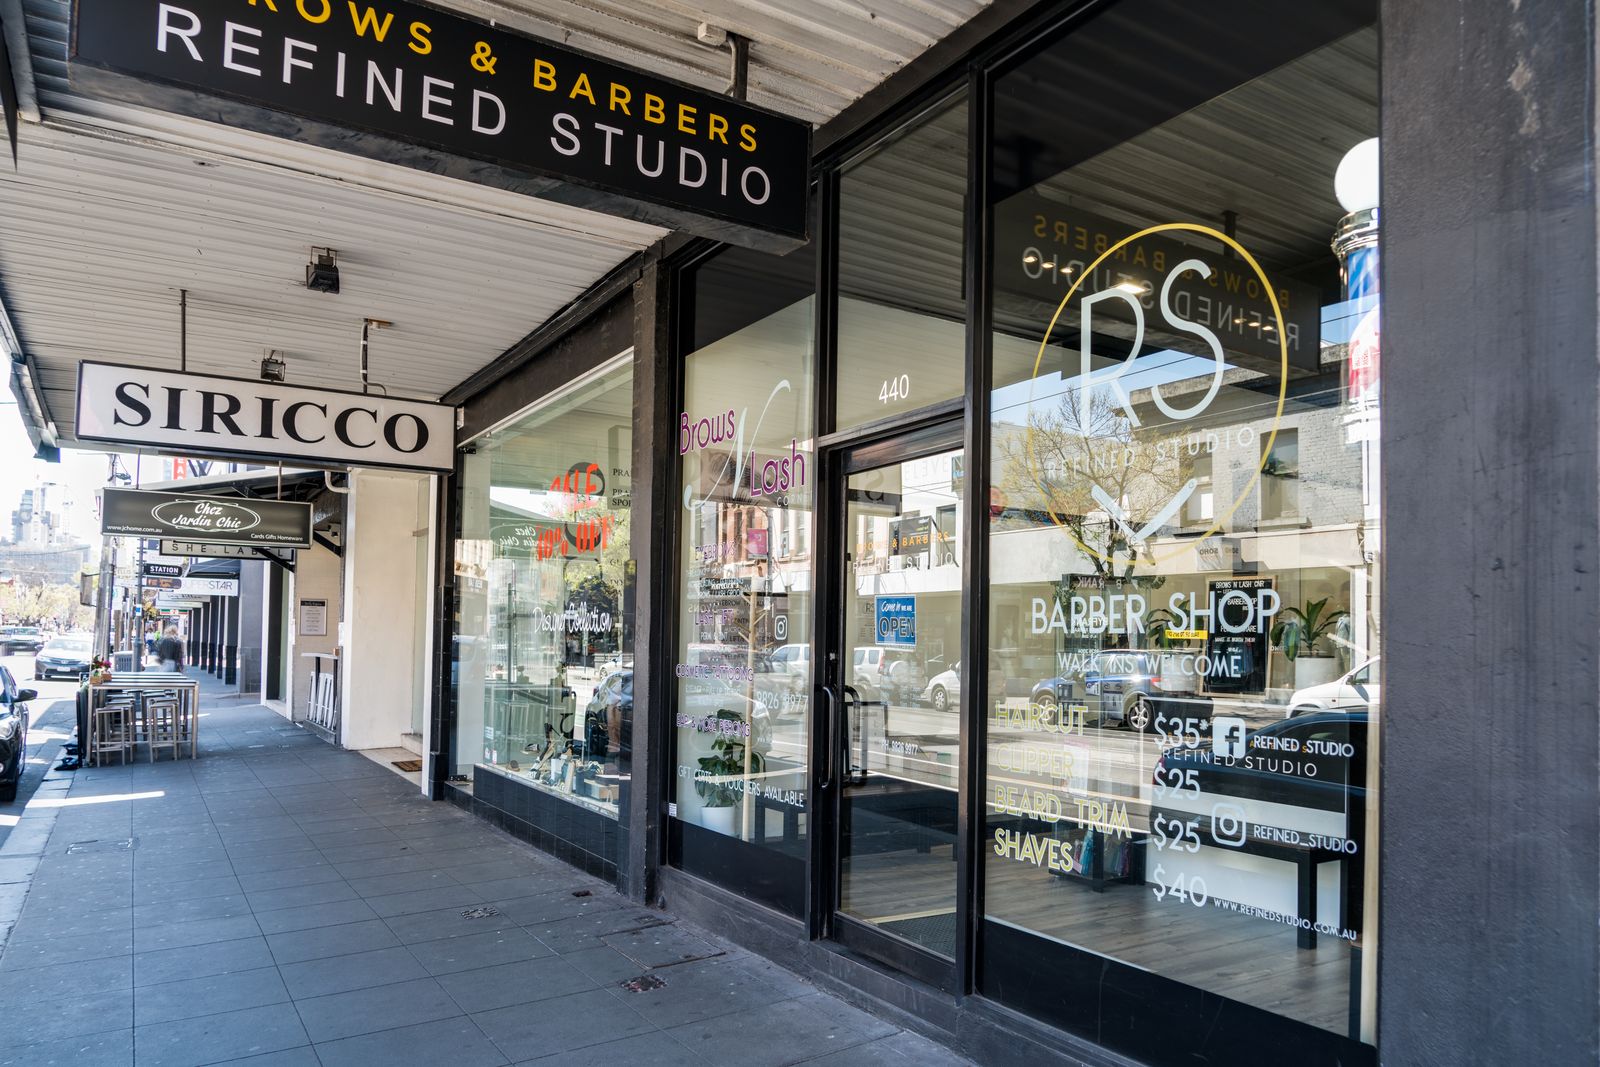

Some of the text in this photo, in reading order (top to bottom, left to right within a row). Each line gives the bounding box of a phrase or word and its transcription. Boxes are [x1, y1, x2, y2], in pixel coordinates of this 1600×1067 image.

[155, 3, 771, 205] REFINED STUDIO
[470, 41, 497, 75] &
[533, 57, 759, 153] BARBERS
[878, 374, 910, 404] 440
[113, 381, 430, 454] SIRICCO
[680, 409, 735, 456] Brows
[750, 437, 806, 498] Lash
[1047, 427, 1256, 479] REFINED STUDIO
[172, 514, 242, 529] Jardin Chic
[195, 502, 224, 516] Chez
[106, 525, 163, 534] www.jchome.com.au
[277, 534, 304, 542] Homeware
[150, 565, 179, 573] STATION
[879, 616, 915, 638] OPEN
[1031, 588, 1281, 635] BARBER SHOP
[1057, 652, 1100, 674] WALK
[1144, 654, 1242, 679] WELCOME
[756, 690, 780, 709] 9826
[995, 700, 1089, 736] HAIRCUT
[996, 744, 1201, 801] CLIPPER $25
[1162, 748, 1318, 777] REFINED STUDIO
[678, 765, 691, 780] GIFT
[764, 785, 805, 808] AVAILABLE
[994, 785, 1201, 854] BEARD TRIM $25
[1253, 824, 1358, 855] REFINED_STUDIO
[994, 827, 1208, 908] SHAVES $40
[1213, 896, 1358, 942] WWW.REFINEDSTUDIO.COM.AU
